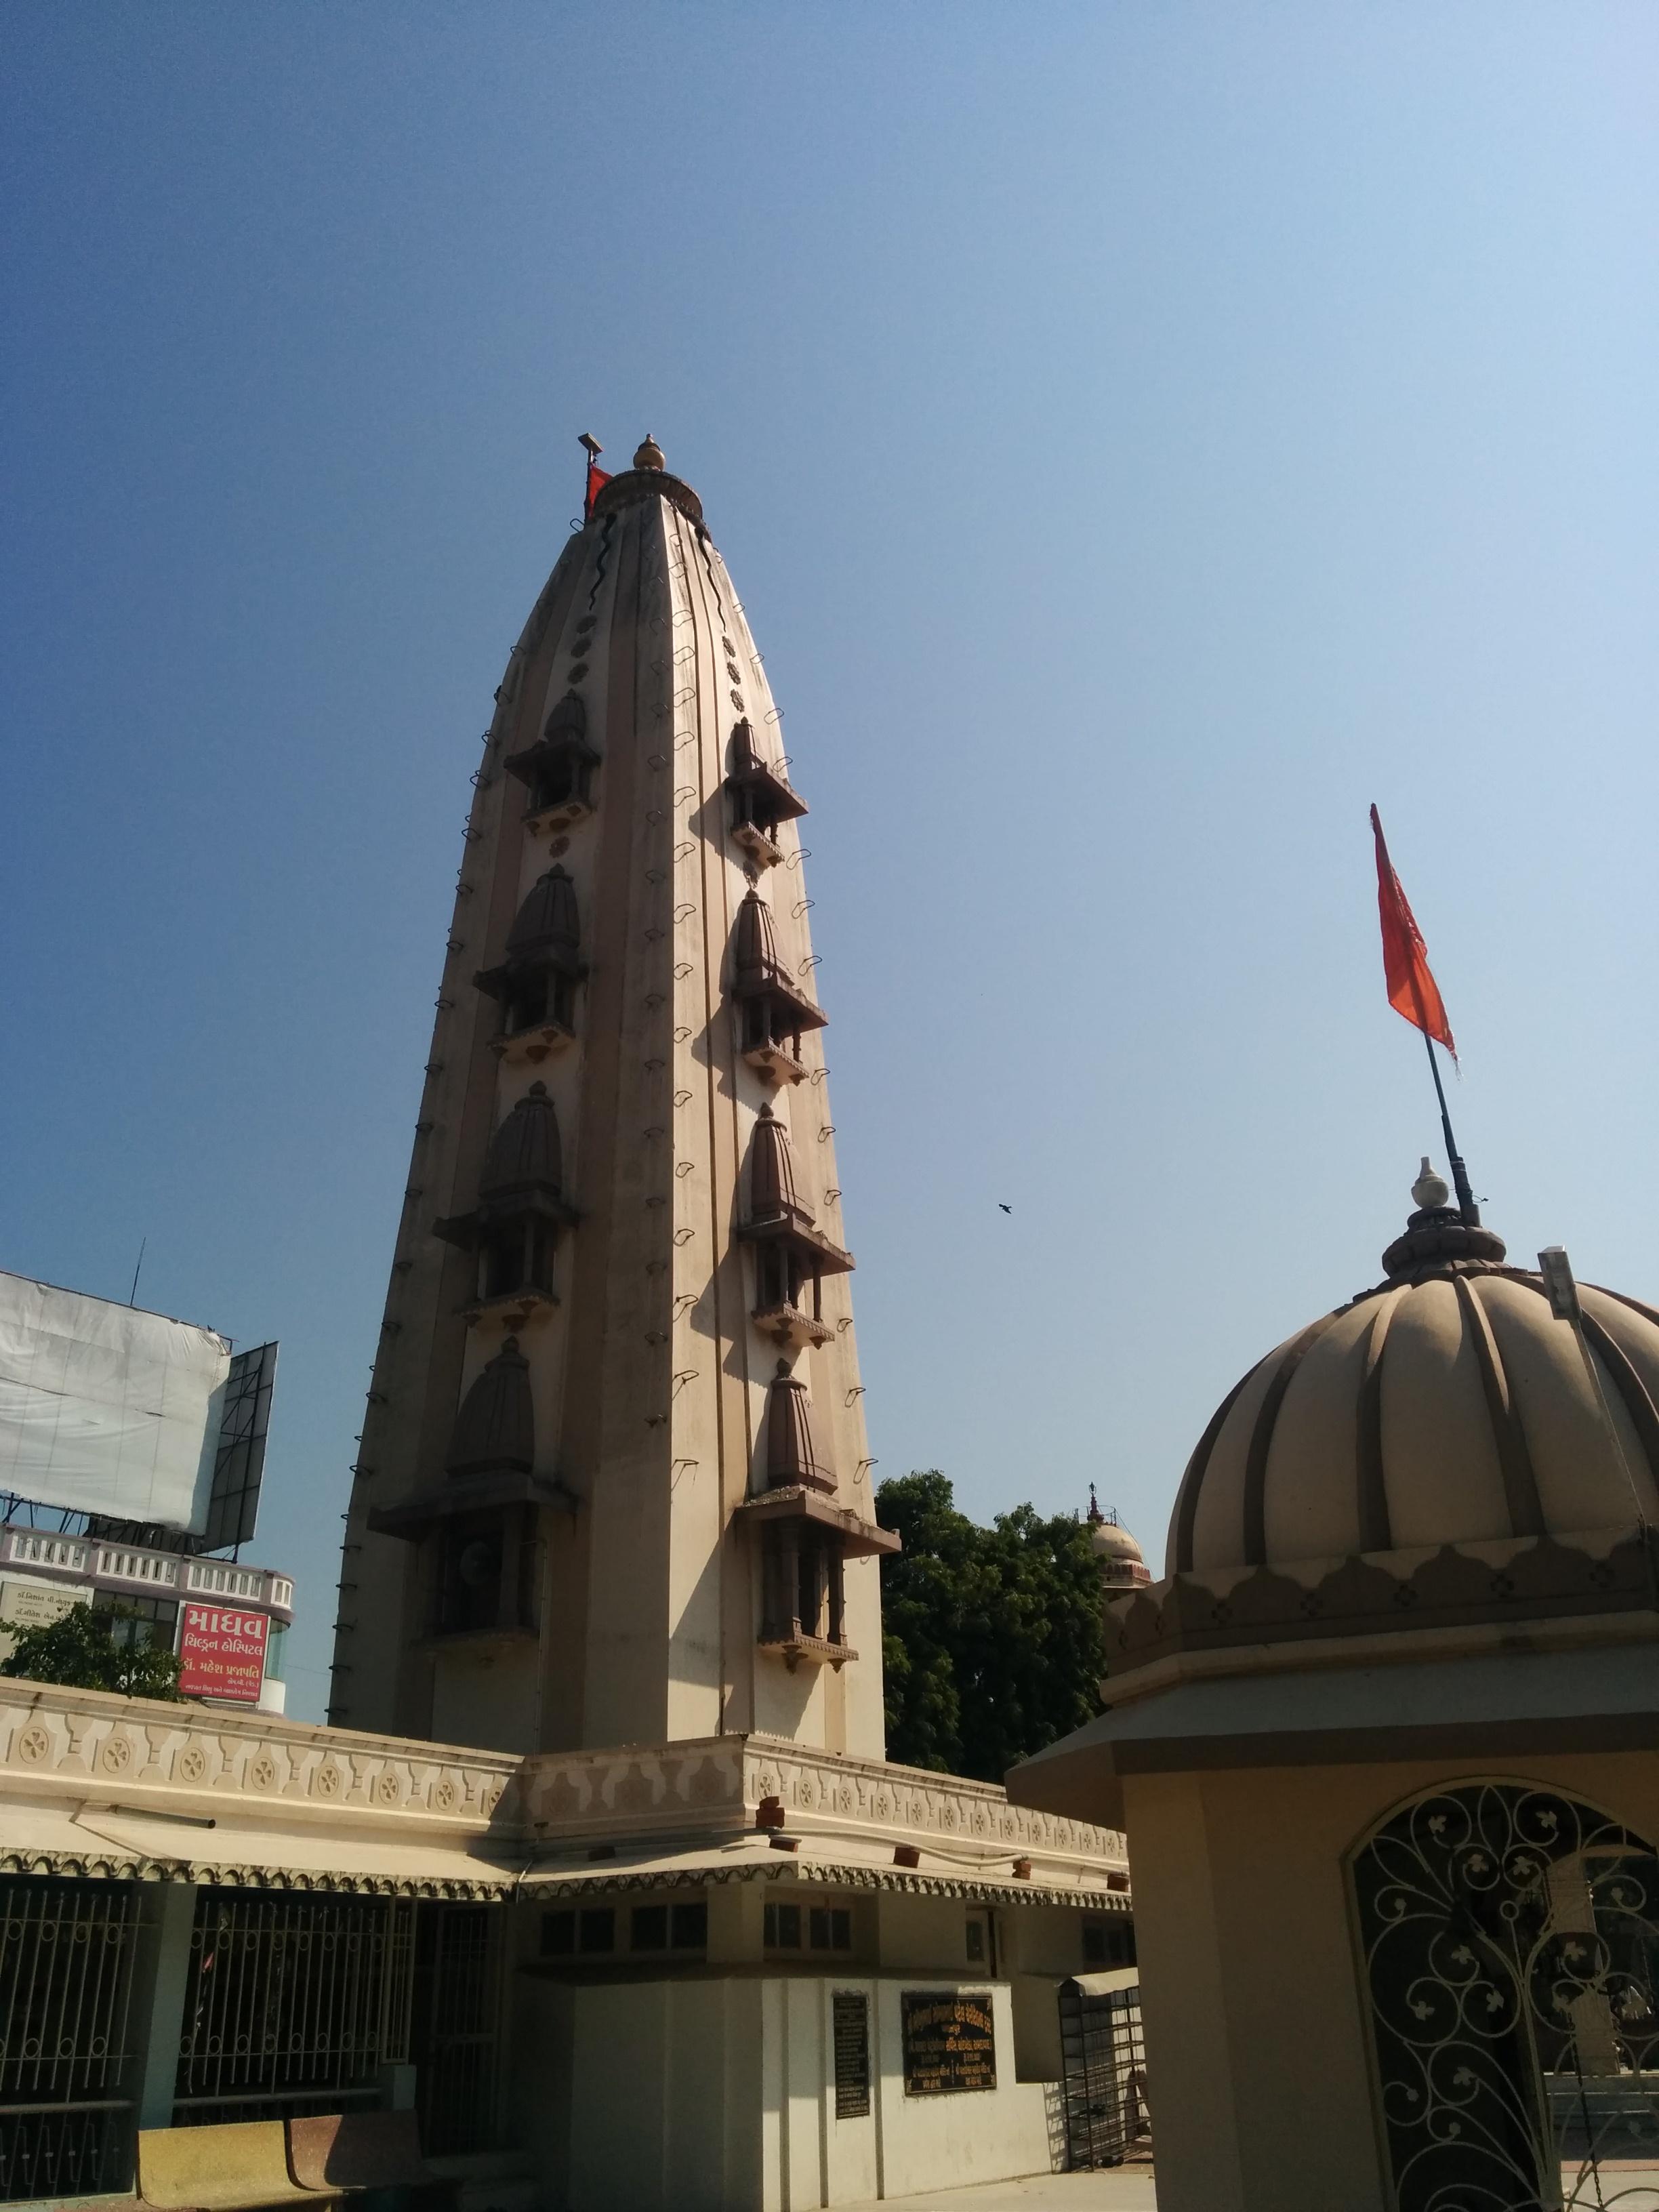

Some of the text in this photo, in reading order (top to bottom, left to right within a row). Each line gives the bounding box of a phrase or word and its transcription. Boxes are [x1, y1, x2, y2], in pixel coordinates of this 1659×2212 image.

[189, 1610, 262, 1639] માધવ
[184, 1633, 262, 1656] ચિલ્ડ્રન હોસ્પિટલ
[200, 1660, 223, 1675] મહેશ
[226, 1664, 260, 1679] પ્રજાપતિ
